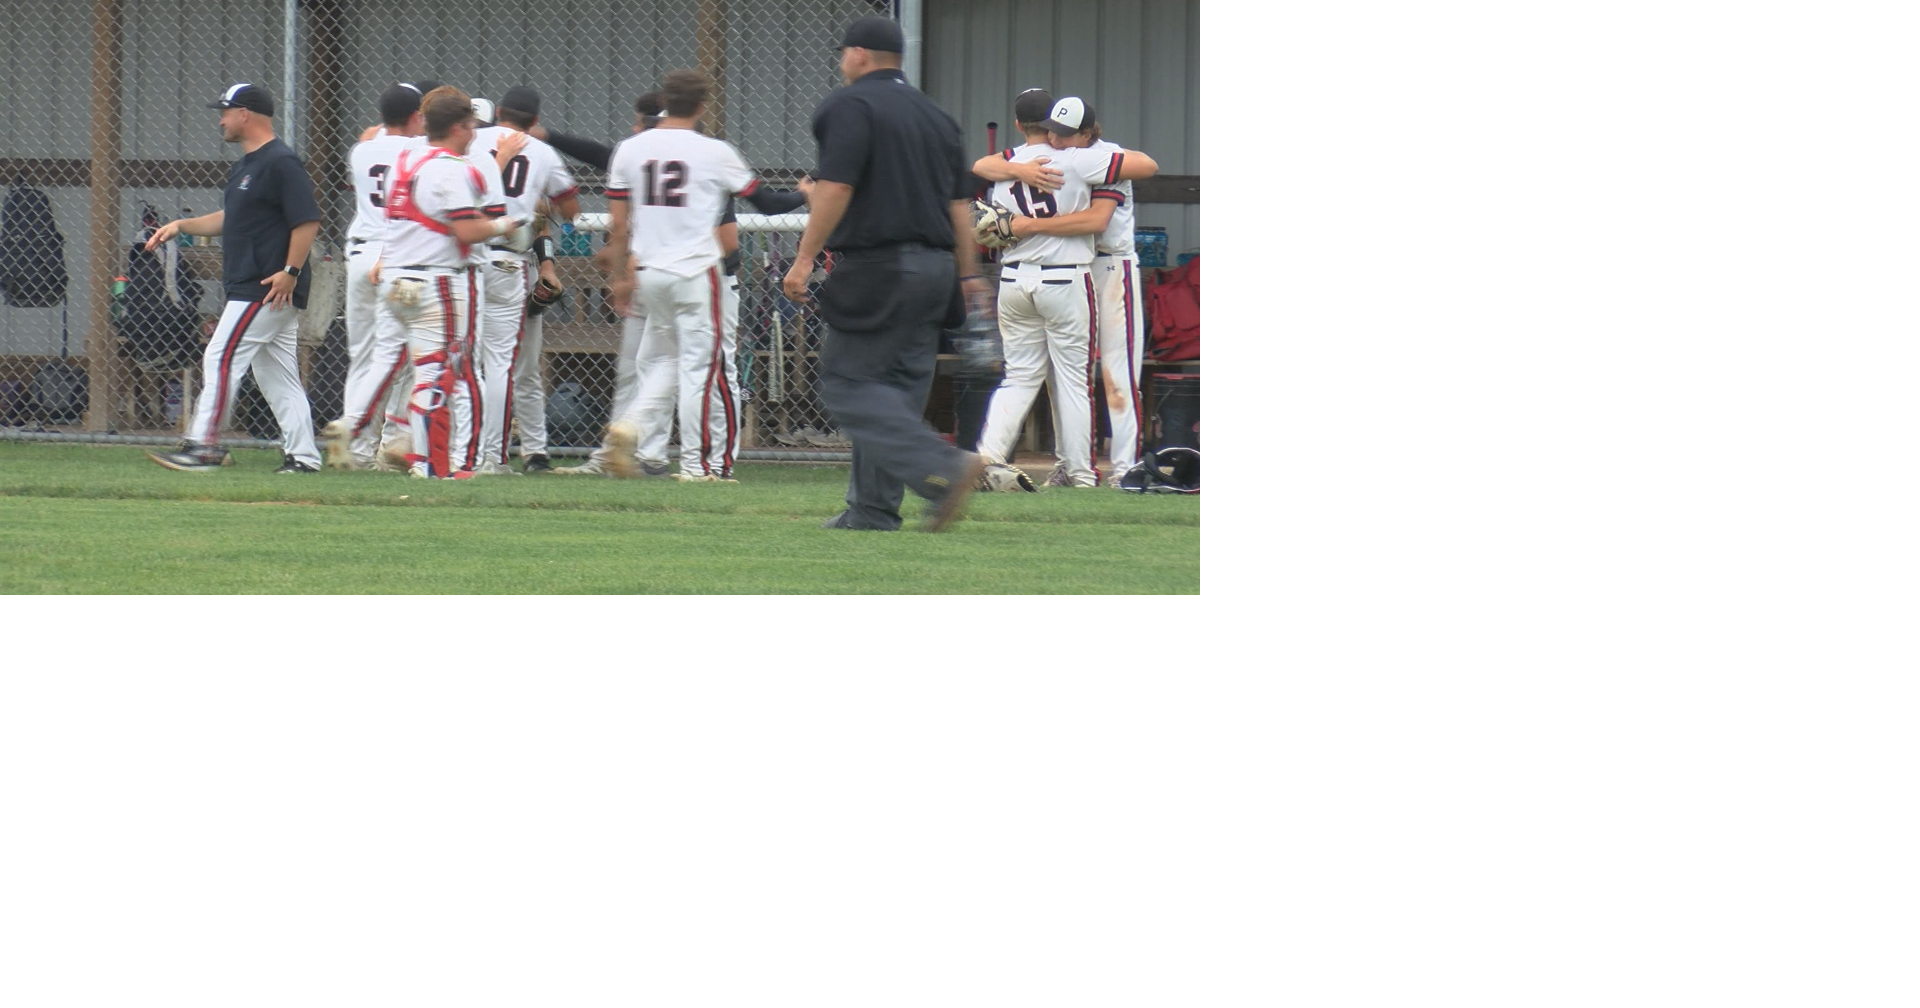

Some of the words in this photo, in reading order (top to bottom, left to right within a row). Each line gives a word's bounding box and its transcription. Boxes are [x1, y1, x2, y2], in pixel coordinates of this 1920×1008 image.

[1057, 107, 1068, 118] P
[641, 159, 689, 207] 12
[1009, 180, 1057, 218] 15
